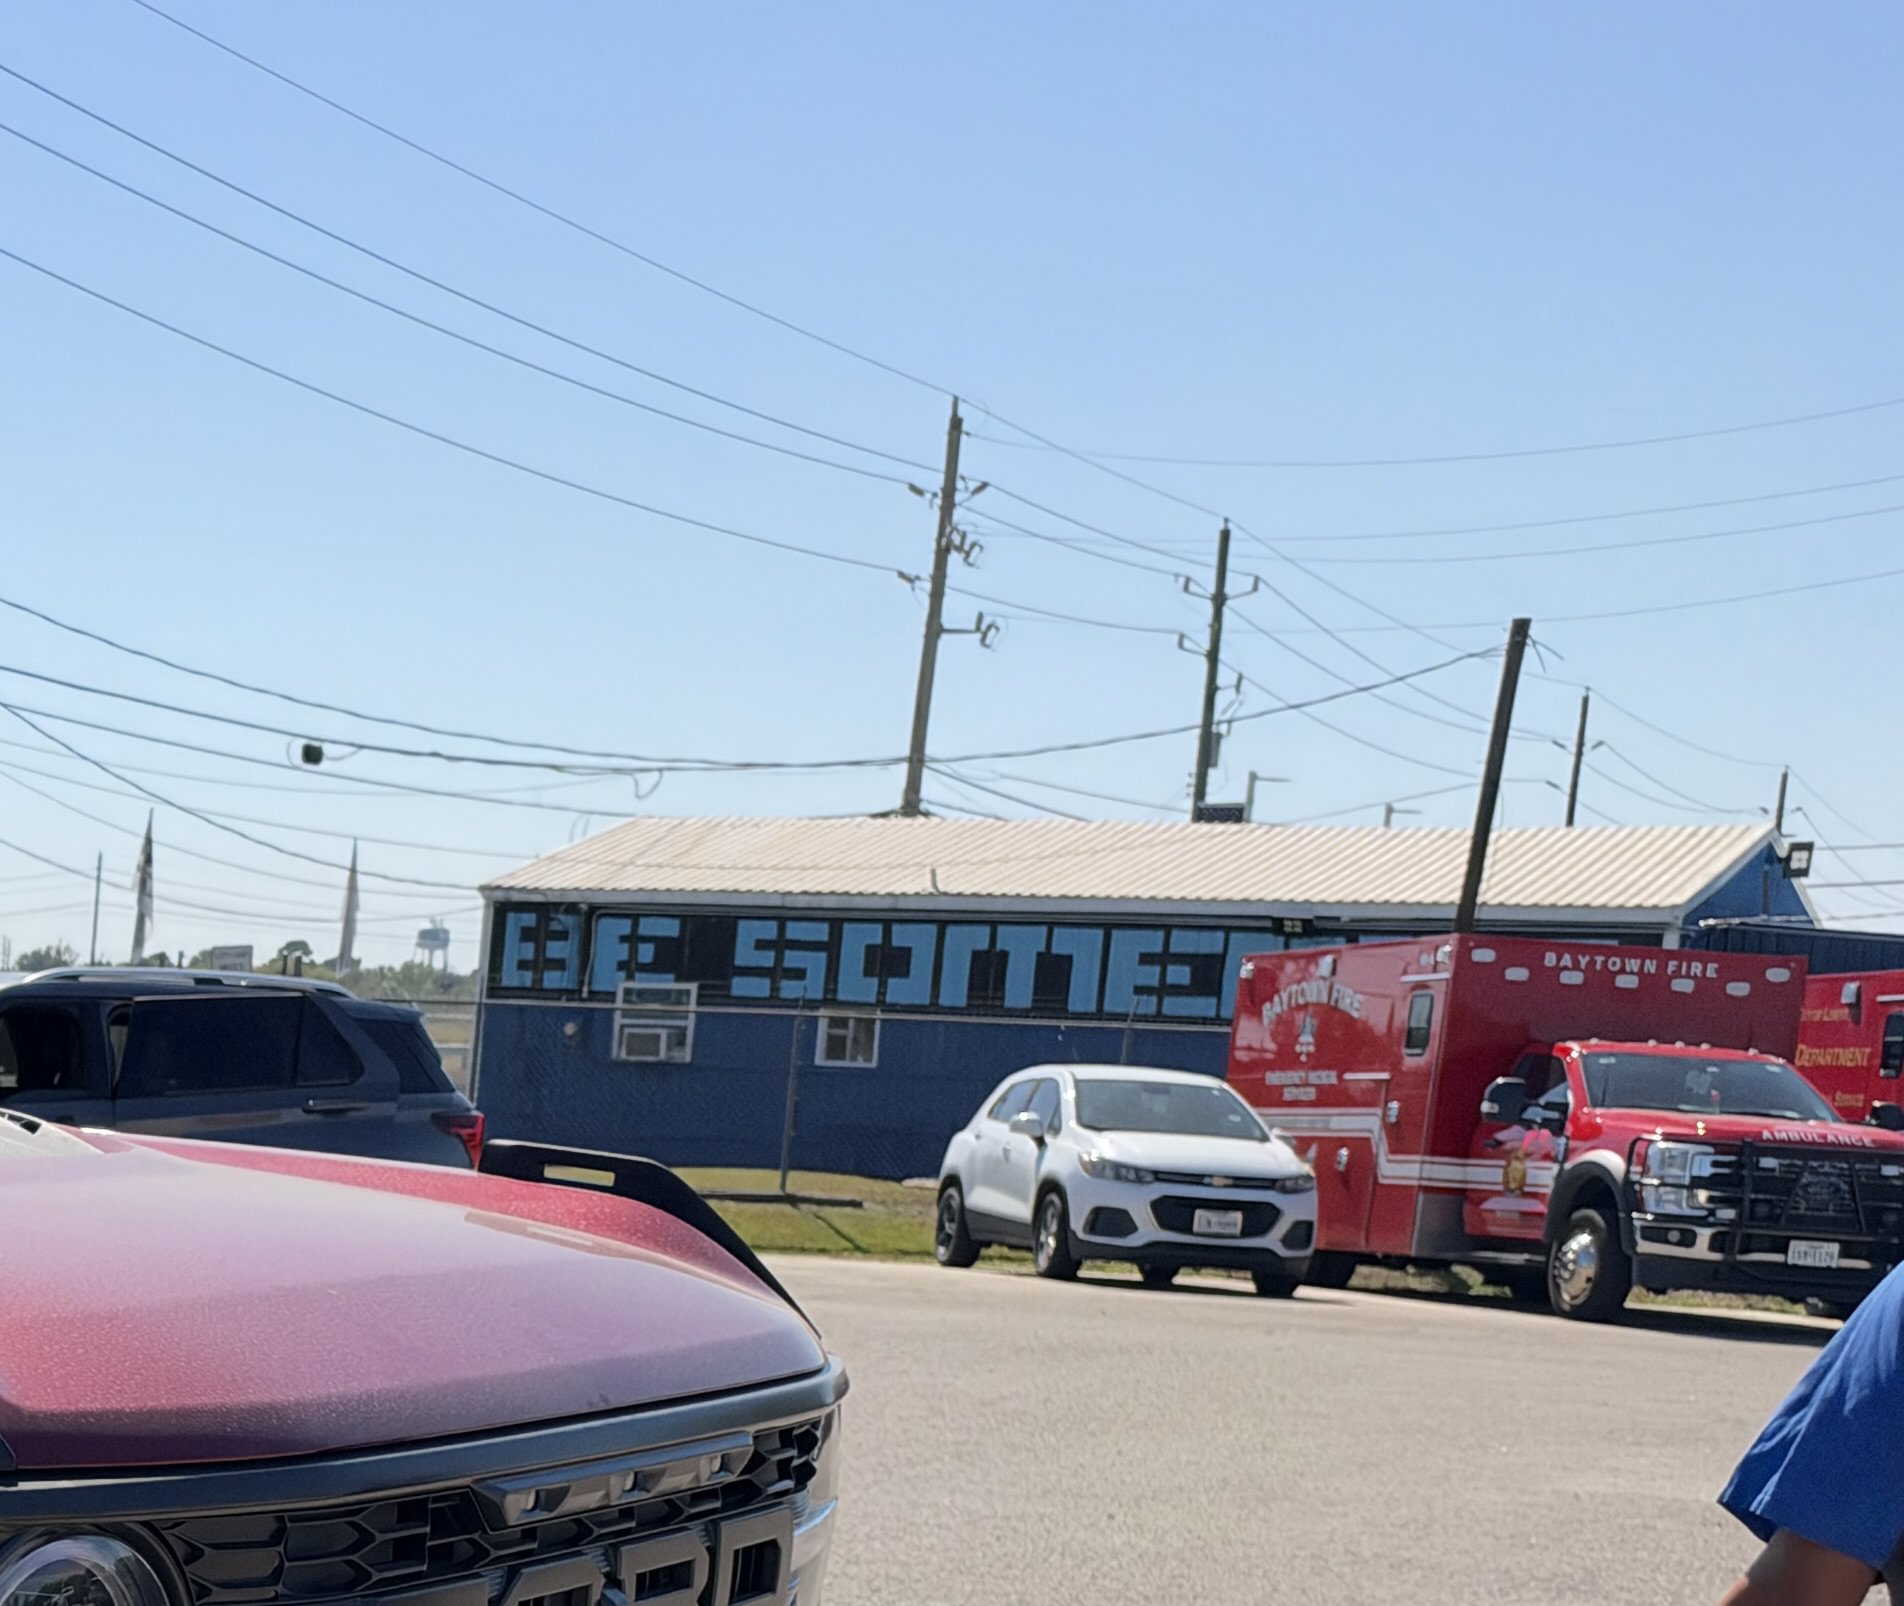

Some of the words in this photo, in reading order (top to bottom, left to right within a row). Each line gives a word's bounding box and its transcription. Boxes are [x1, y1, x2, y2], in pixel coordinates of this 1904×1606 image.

[501, 911, 682, 993] BE
[1544, 951, 1658, 974] BAYTOWN
[1667, 960, 1720, 979] FIRE
[1262, 979, 1330, 1027] BAYTOWN
[1330, 981, 1362, 1019] FIRE
[1761, 1129, 1876, 1148] AMBULANCE
